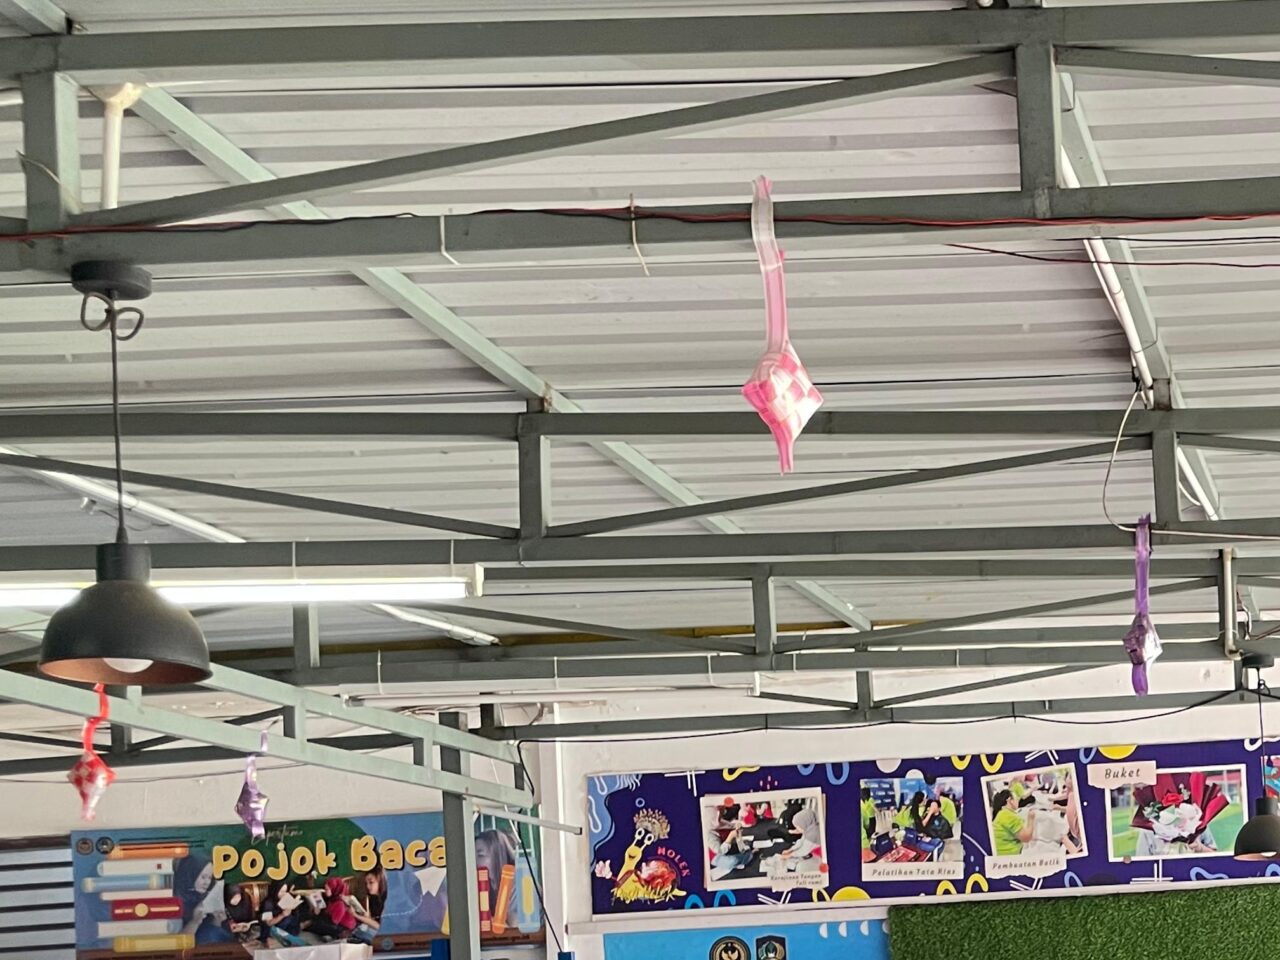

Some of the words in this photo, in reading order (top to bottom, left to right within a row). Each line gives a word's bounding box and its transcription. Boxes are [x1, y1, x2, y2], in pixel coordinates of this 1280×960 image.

[1103, 767, 1142, 780] Buket
[211, 839, 338, 881] Pojok
[872, 868, 913, 877] Pelatihan
[916, 867, 935, 876] Tata
[937, 867, 956, 875] Rias
